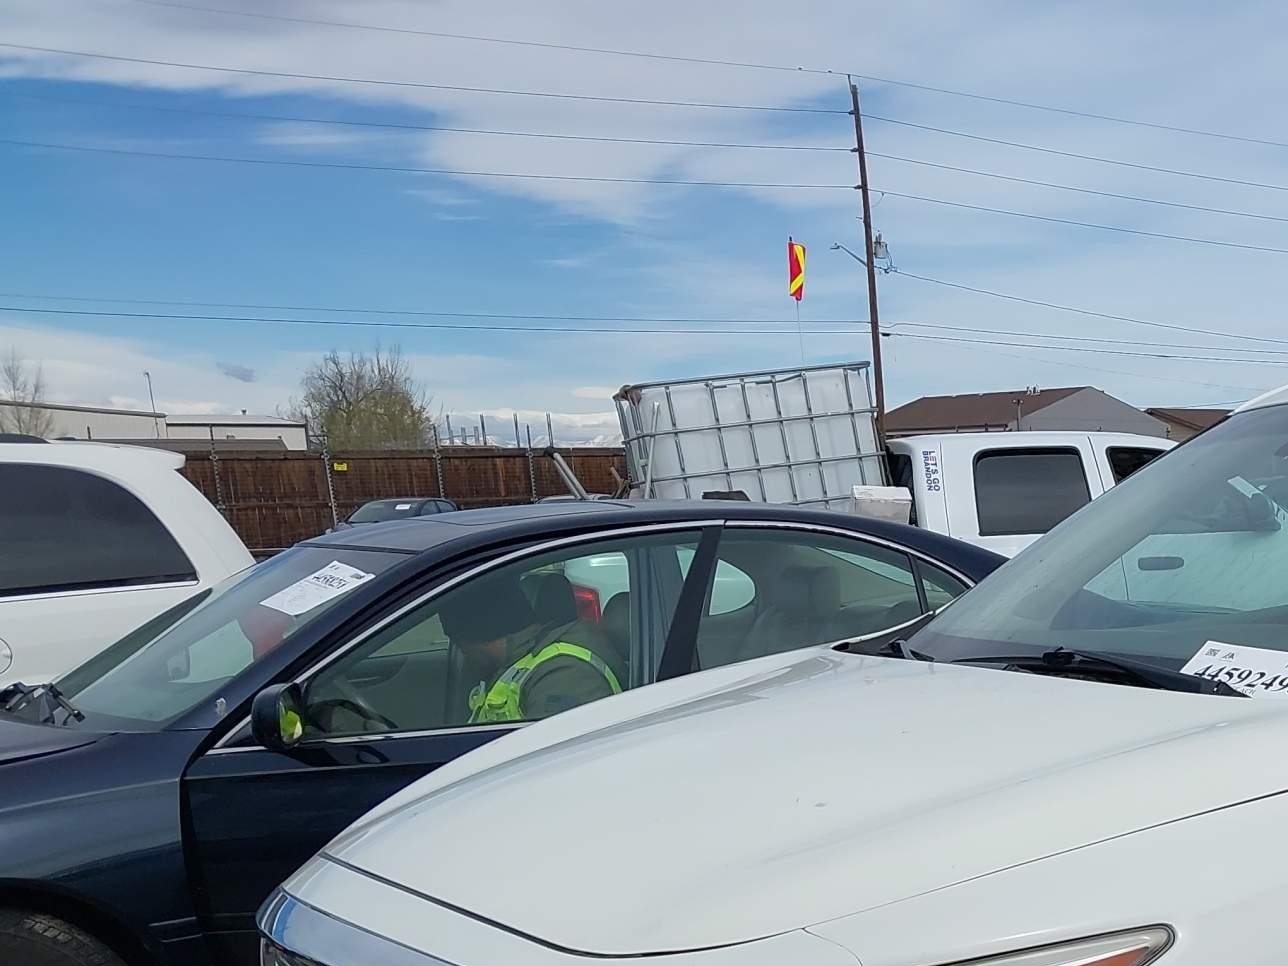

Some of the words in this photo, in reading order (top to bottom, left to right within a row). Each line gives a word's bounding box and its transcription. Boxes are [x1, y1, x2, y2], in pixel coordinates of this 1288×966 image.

[922, 450, 934, 492] BRANDON
[929, 450, 939, 475] LETS
[932, 477, 941, 492] GO
